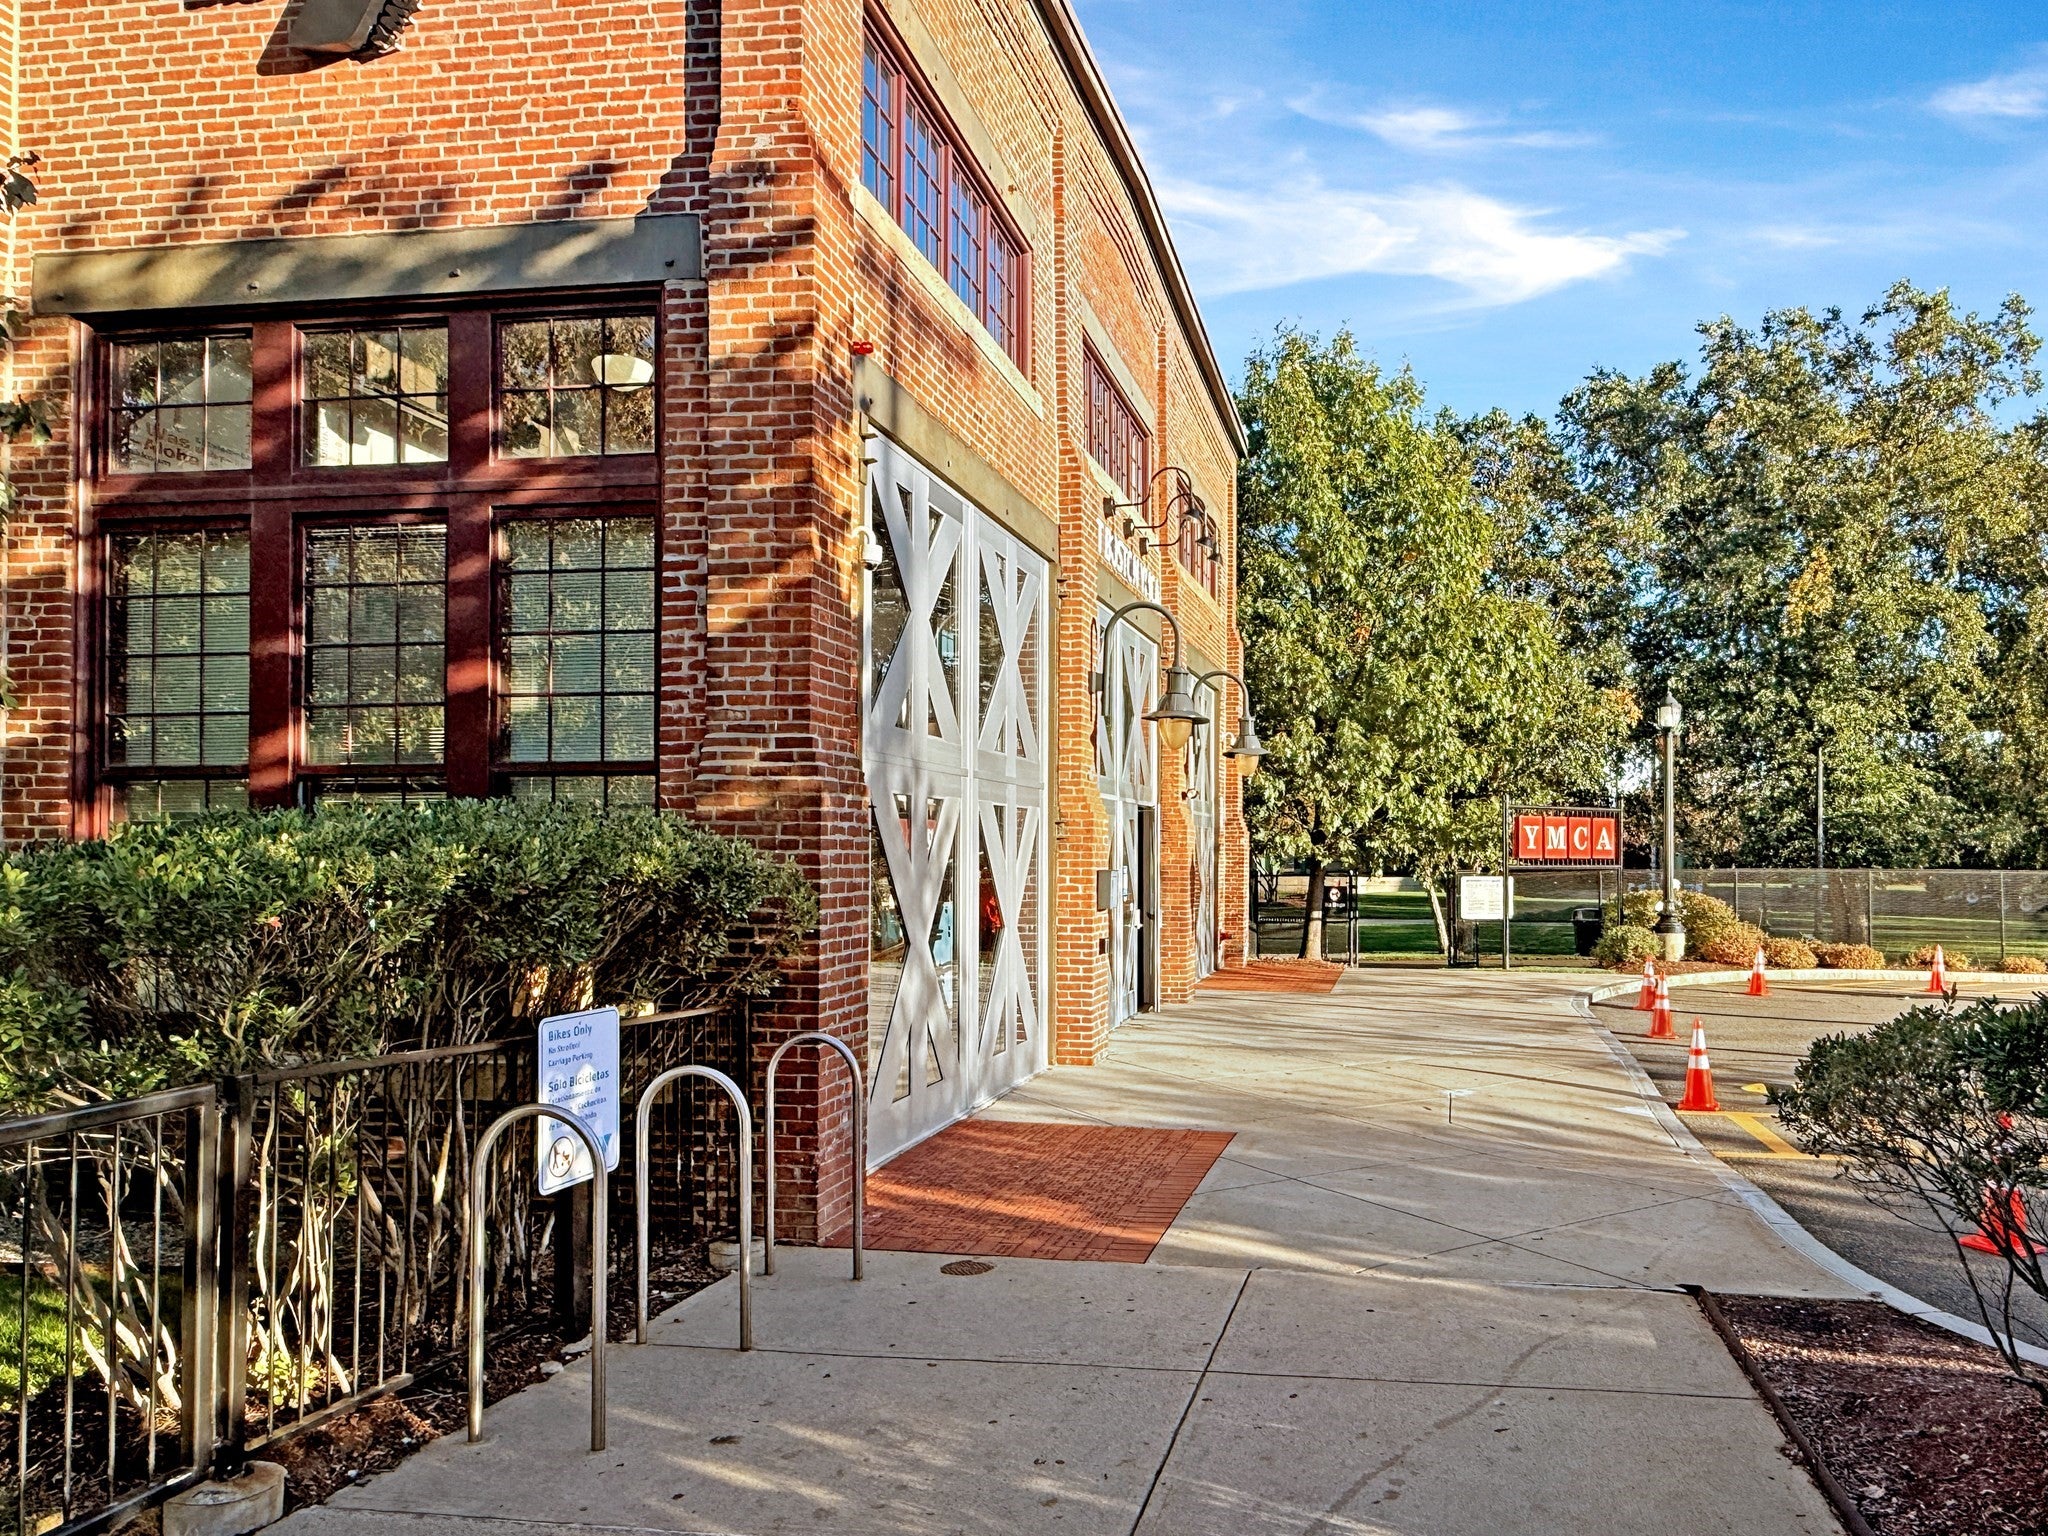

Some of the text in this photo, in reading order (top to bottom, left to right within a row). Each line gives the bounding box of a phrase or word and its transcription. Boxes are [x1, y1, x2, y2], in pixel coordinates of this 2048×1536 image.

[1523, 825, 1612, 851] YMCA
[548, 1024, 592, 1041] Bikes Only
[569, 1070, 609, 1087] Bicicletas
